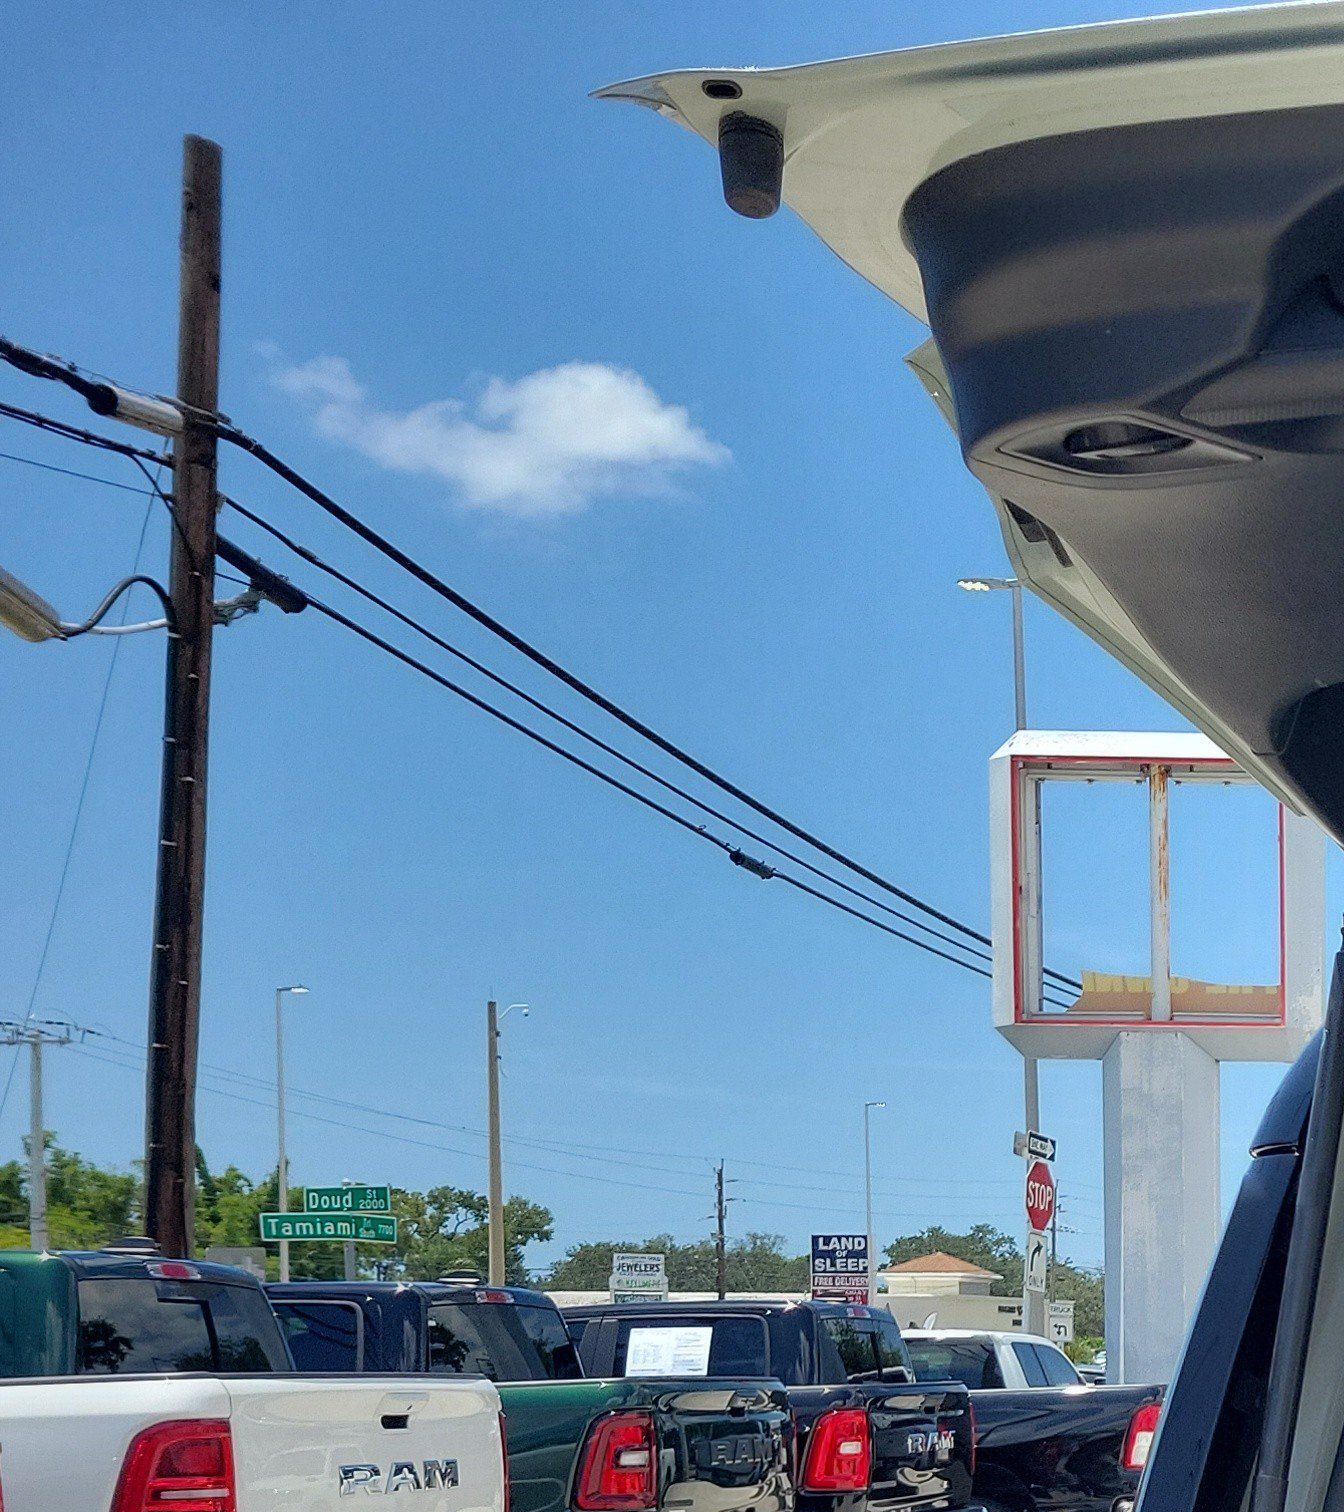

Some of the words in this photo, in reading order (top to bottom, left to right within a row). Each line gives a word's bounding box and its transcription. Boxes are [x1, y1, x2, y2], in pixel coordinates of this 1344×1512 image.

[309, 1192, 352, 1209] Doud
[359, 1199, 385, 1209] 2000
[366, 1189, 377, 1199] St
[1028, 1181, 1053, 1211] STOP
[267, 1218, 355, 1236] Tamiami
[818, 1237, 866, 1251] LAND
[616, 1262, 661, 1273] JEWELERS
[814, 1258, 869, 1272] SLEEP
[814, 1276, 834, 1286] FREE
[908, 1430, 956, 1455] RAM
[710, 1438, 774, 1466] RAM
[338, 1458, 461, 1497] RAM
